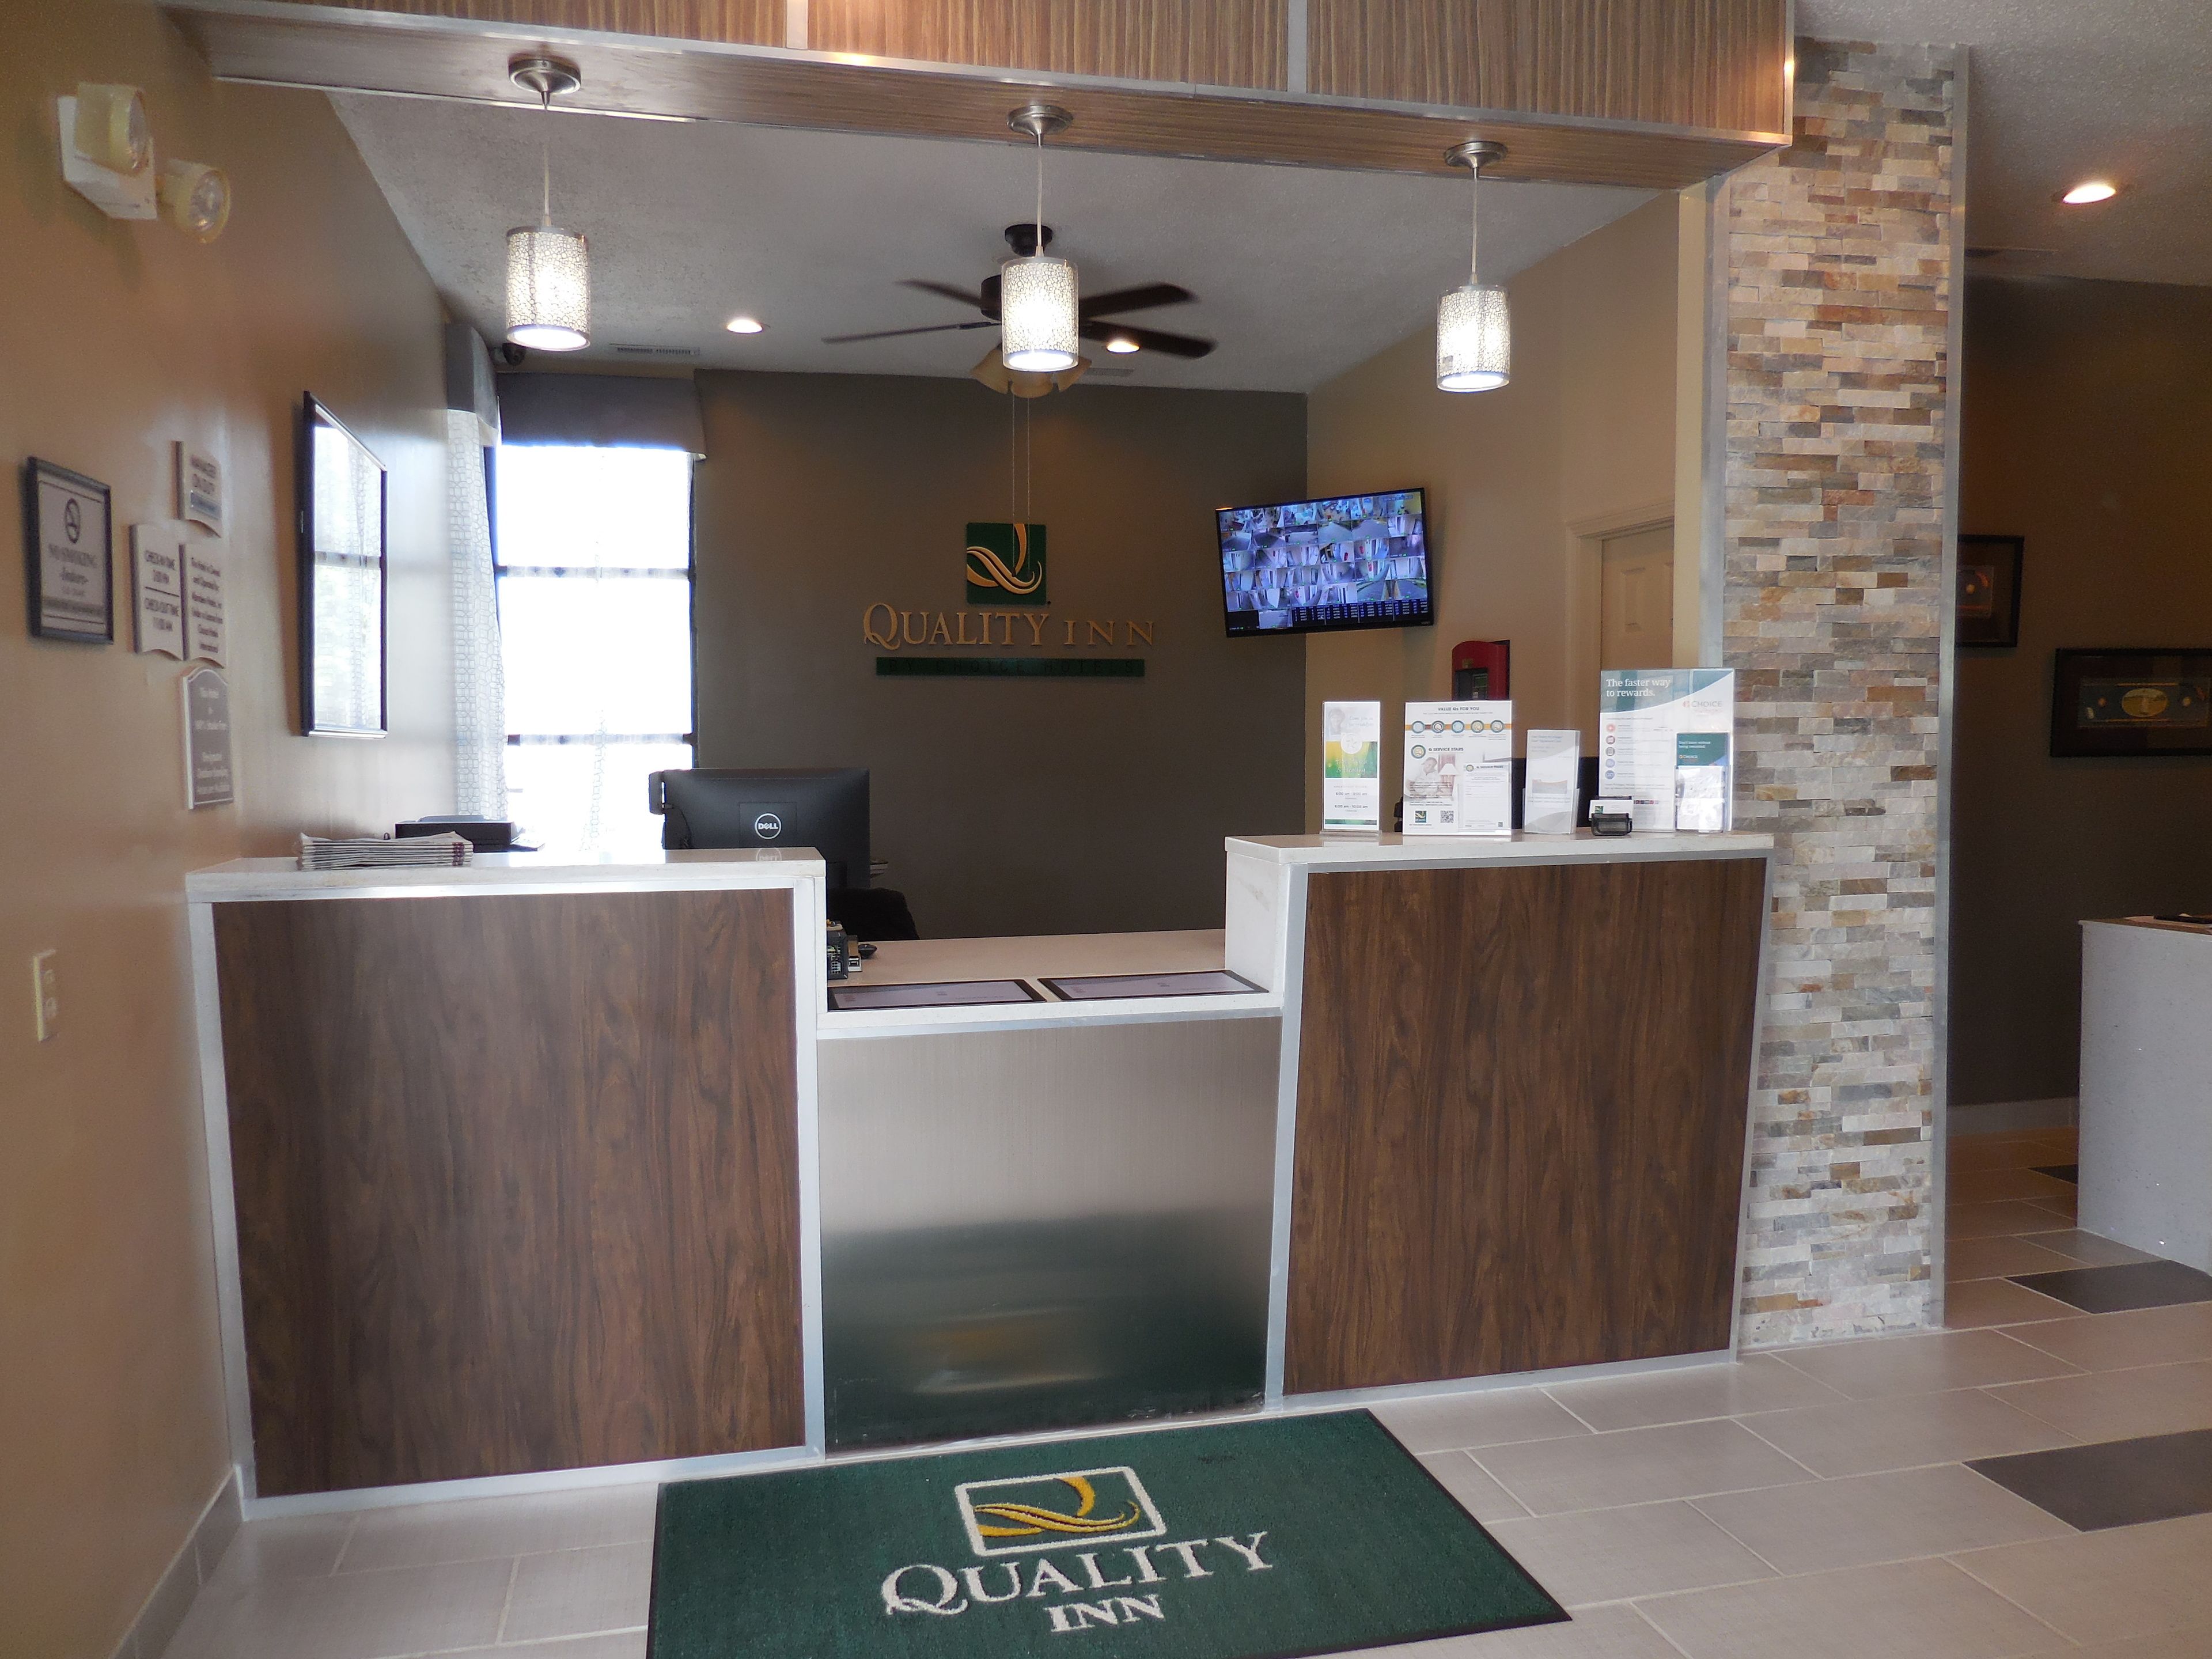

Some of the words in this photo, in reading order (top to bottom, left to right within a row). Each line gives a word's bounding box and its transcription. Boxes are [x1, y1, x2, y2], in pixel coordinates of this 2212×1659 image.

[863, 603, 1050, 650] QUALITY
[1063, 620, 1154, 646] INN
[1605, 679, 1623, 687] The
[1624, 679, 1650, 687] faster
[1652, 680, 1671, 688] way
[1616, 688, 1656, 697] rewards.
[881, 1531, 1272, 1615] QUALITY
[1044, 1594, 1164, 1632] INN
